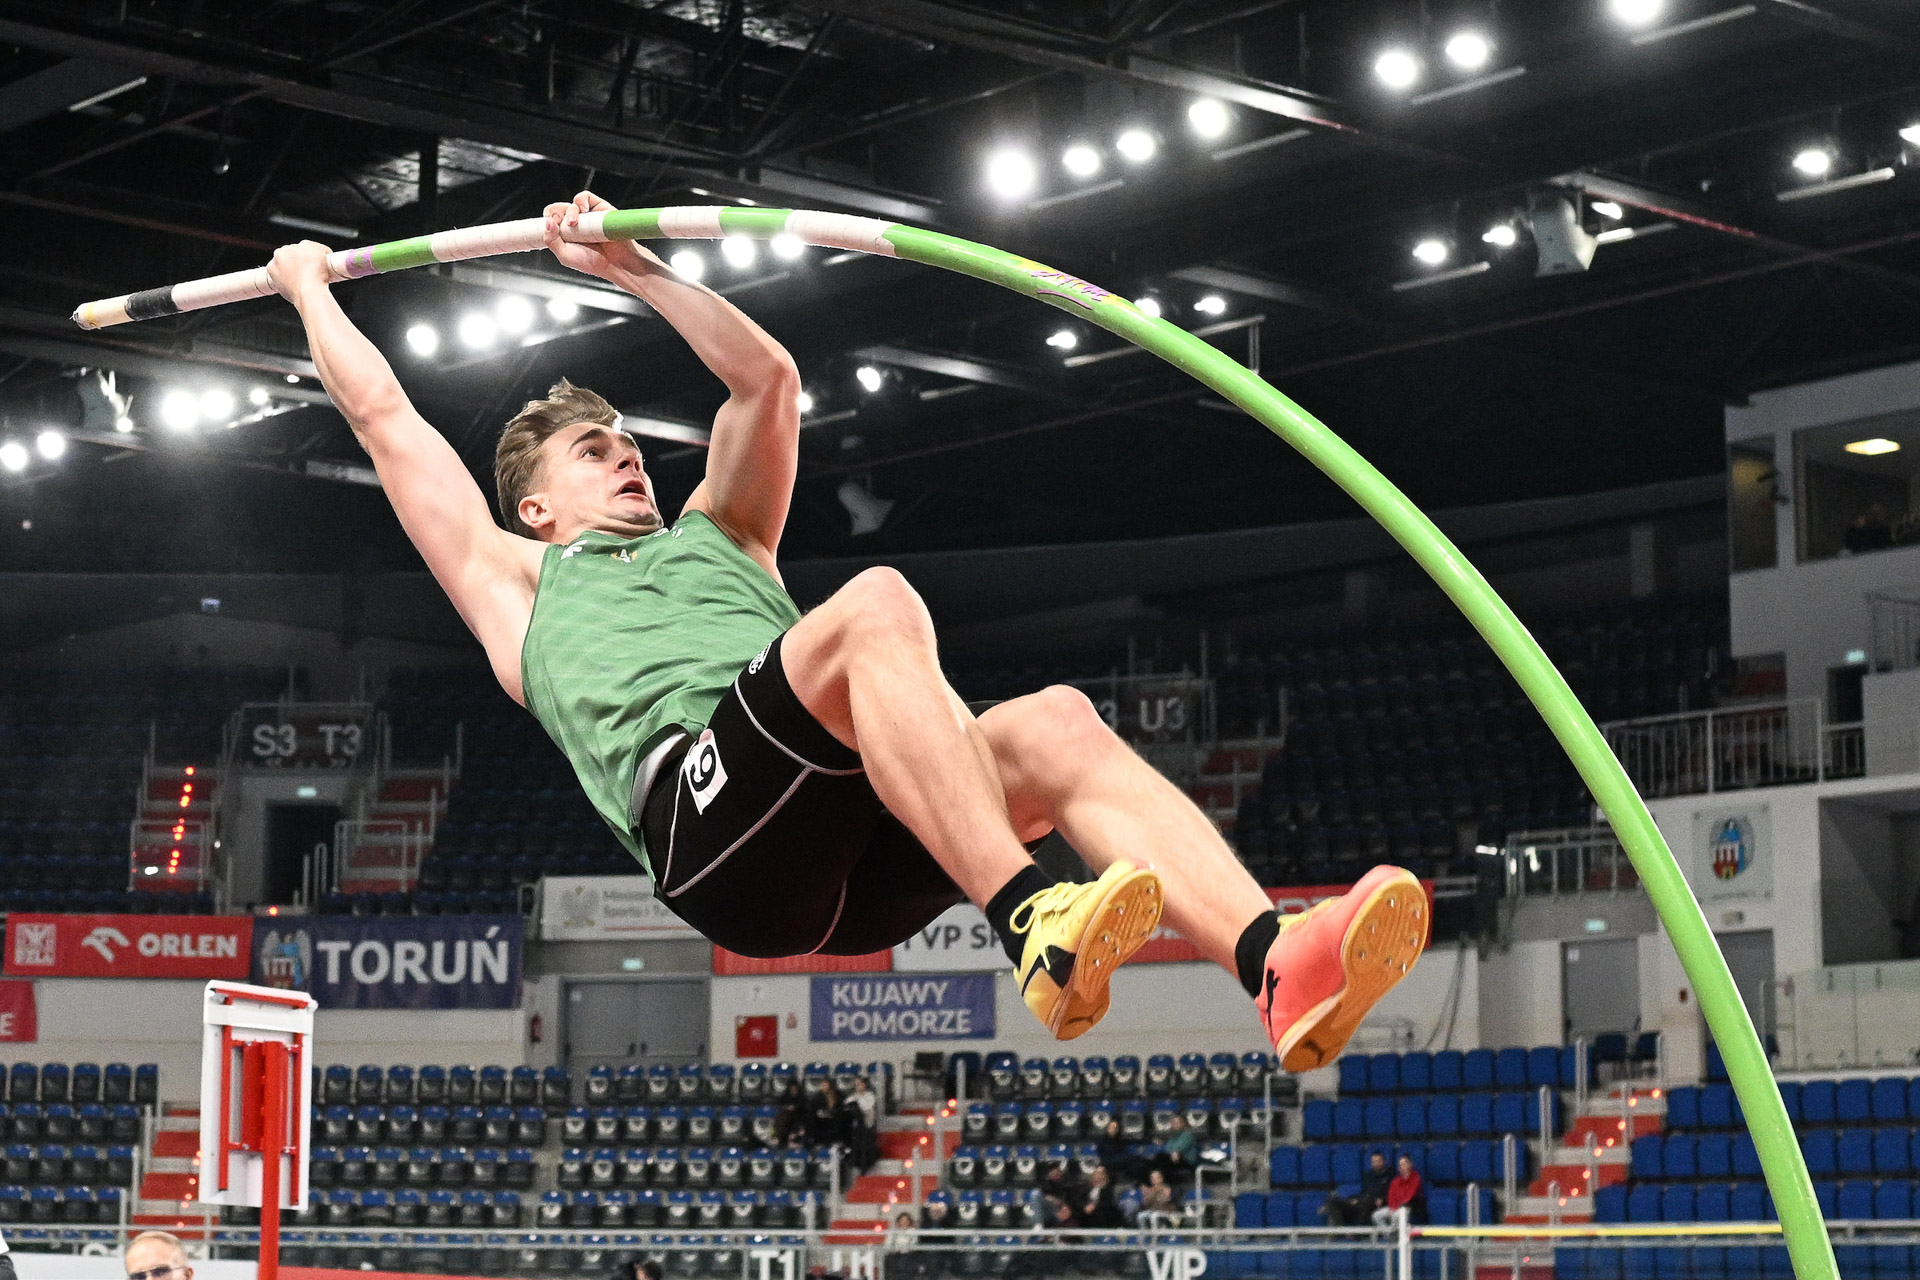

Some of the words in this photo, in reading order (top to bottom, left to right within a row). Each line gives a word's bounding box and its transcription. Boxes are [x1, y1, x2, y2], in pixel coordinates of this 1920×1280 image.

[1140, 698, 1186, 732] U3
[252, 724, 297, 756] S3
[318, 724, 361, 756] T3
[138, 932, 238, 958] ORLEN
[904, 924, 961, 950] VP
[316, 925, 509, 985] TORUŃ
[832, 981, 949, 1007] KUJAWY
[832, 1009, 972, 1036] POMORZE
[751, 1250, 794, 1280] T1
[1146, 1249, 1207, 1280] VIP
